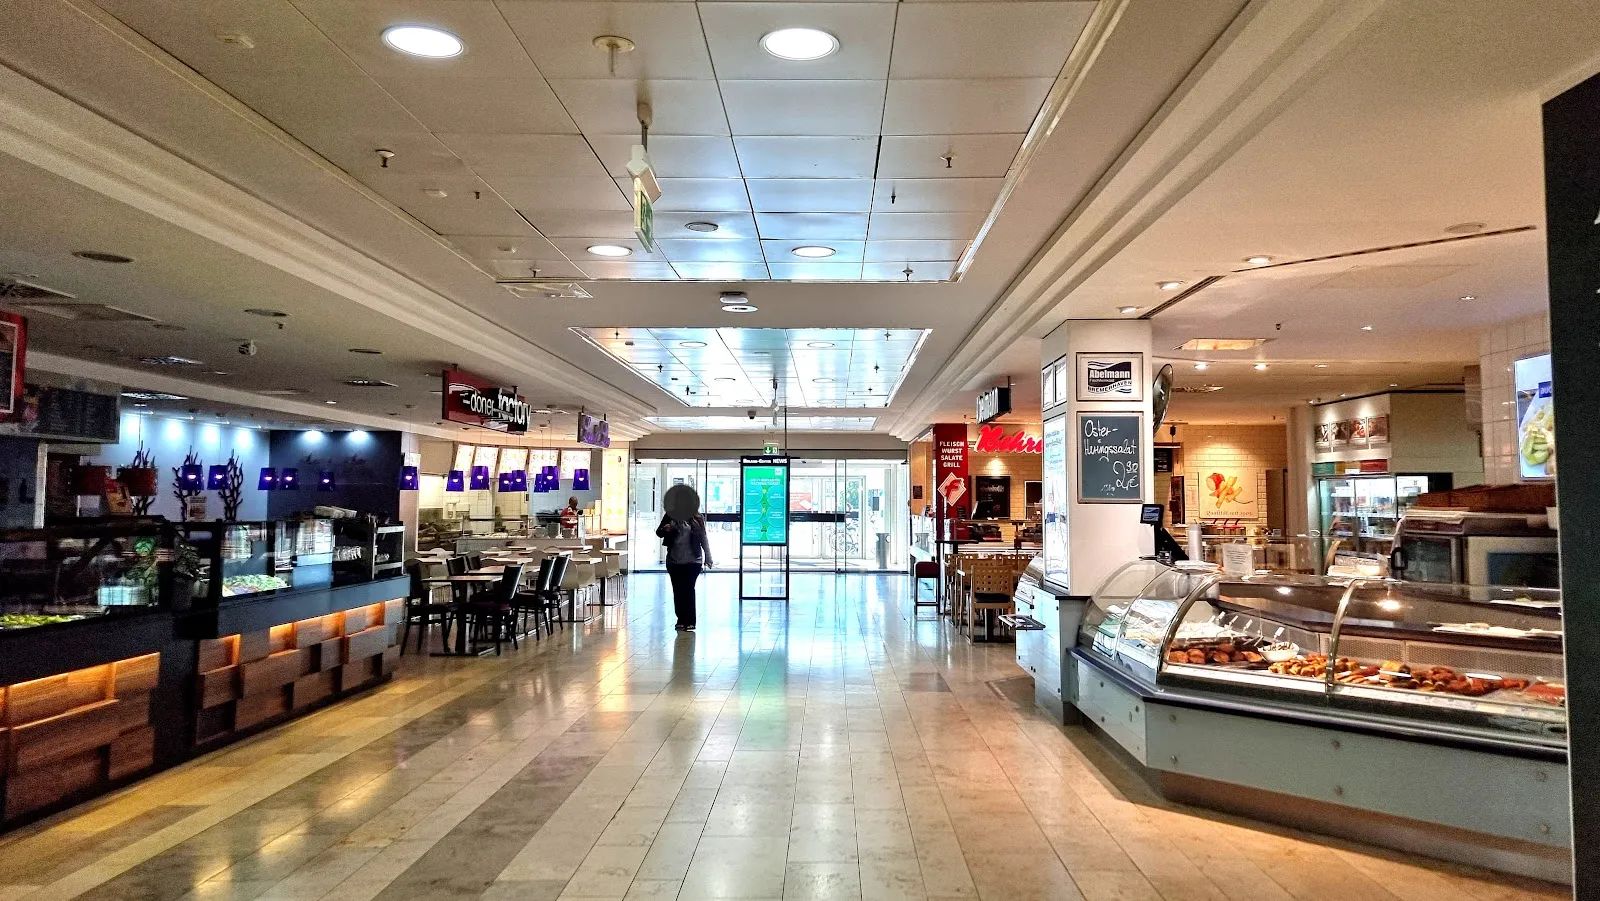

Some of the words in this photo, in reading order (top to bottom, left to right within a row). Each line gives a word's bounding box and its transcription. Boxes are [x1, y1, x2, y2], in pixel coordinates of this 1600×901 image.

[1089, 370, 1130, 379] Abelmann
[1088, 380, 1132, 393] BREMERHAVEN
[1084, 419, 1119, 437] Oster-
